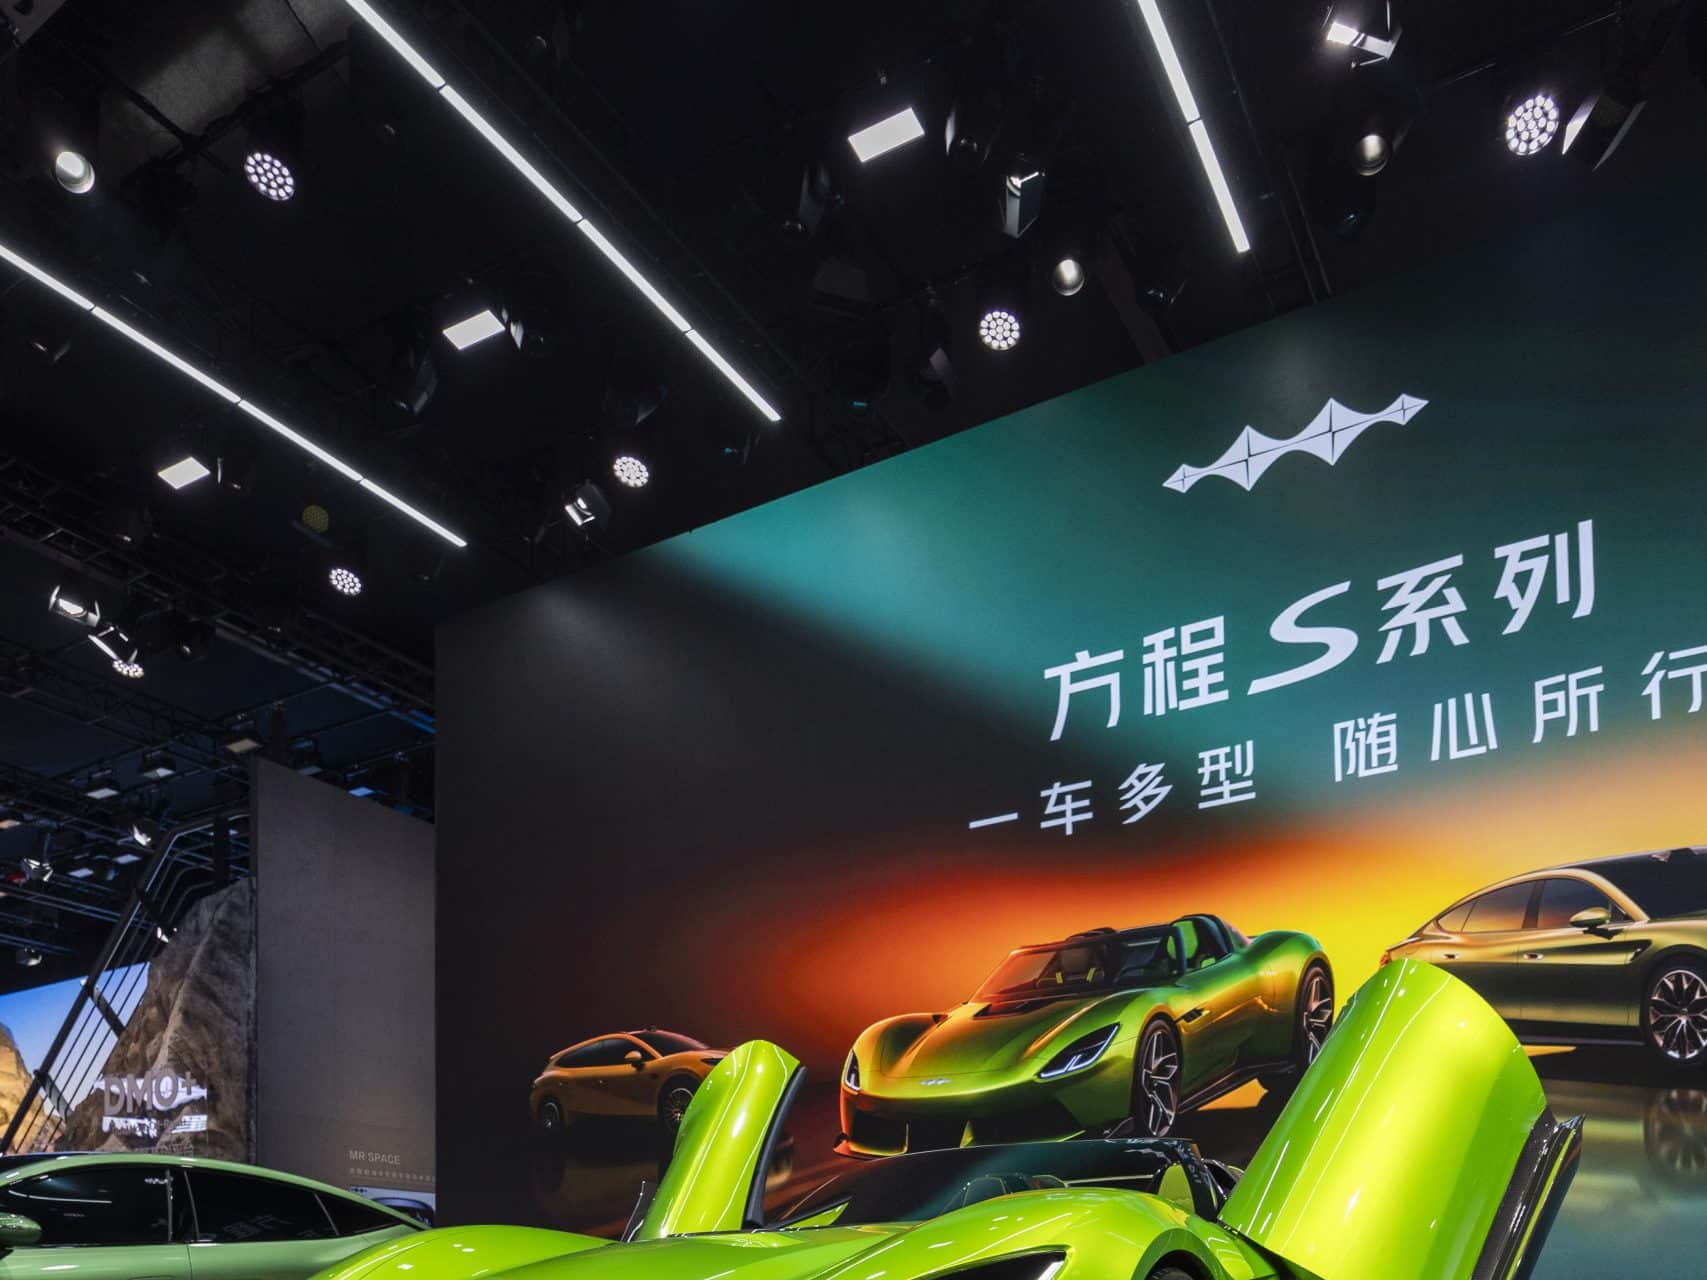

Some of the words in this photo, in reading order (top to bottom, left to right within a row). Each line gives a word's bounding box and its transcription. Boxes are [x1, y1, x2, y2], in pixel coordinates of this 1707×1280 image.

[1043, 518, 1596, 742] 方程S系列
[968, 740, 1257, 836] 一车多型
[1332, 645, 1707, 783] 随心所行
